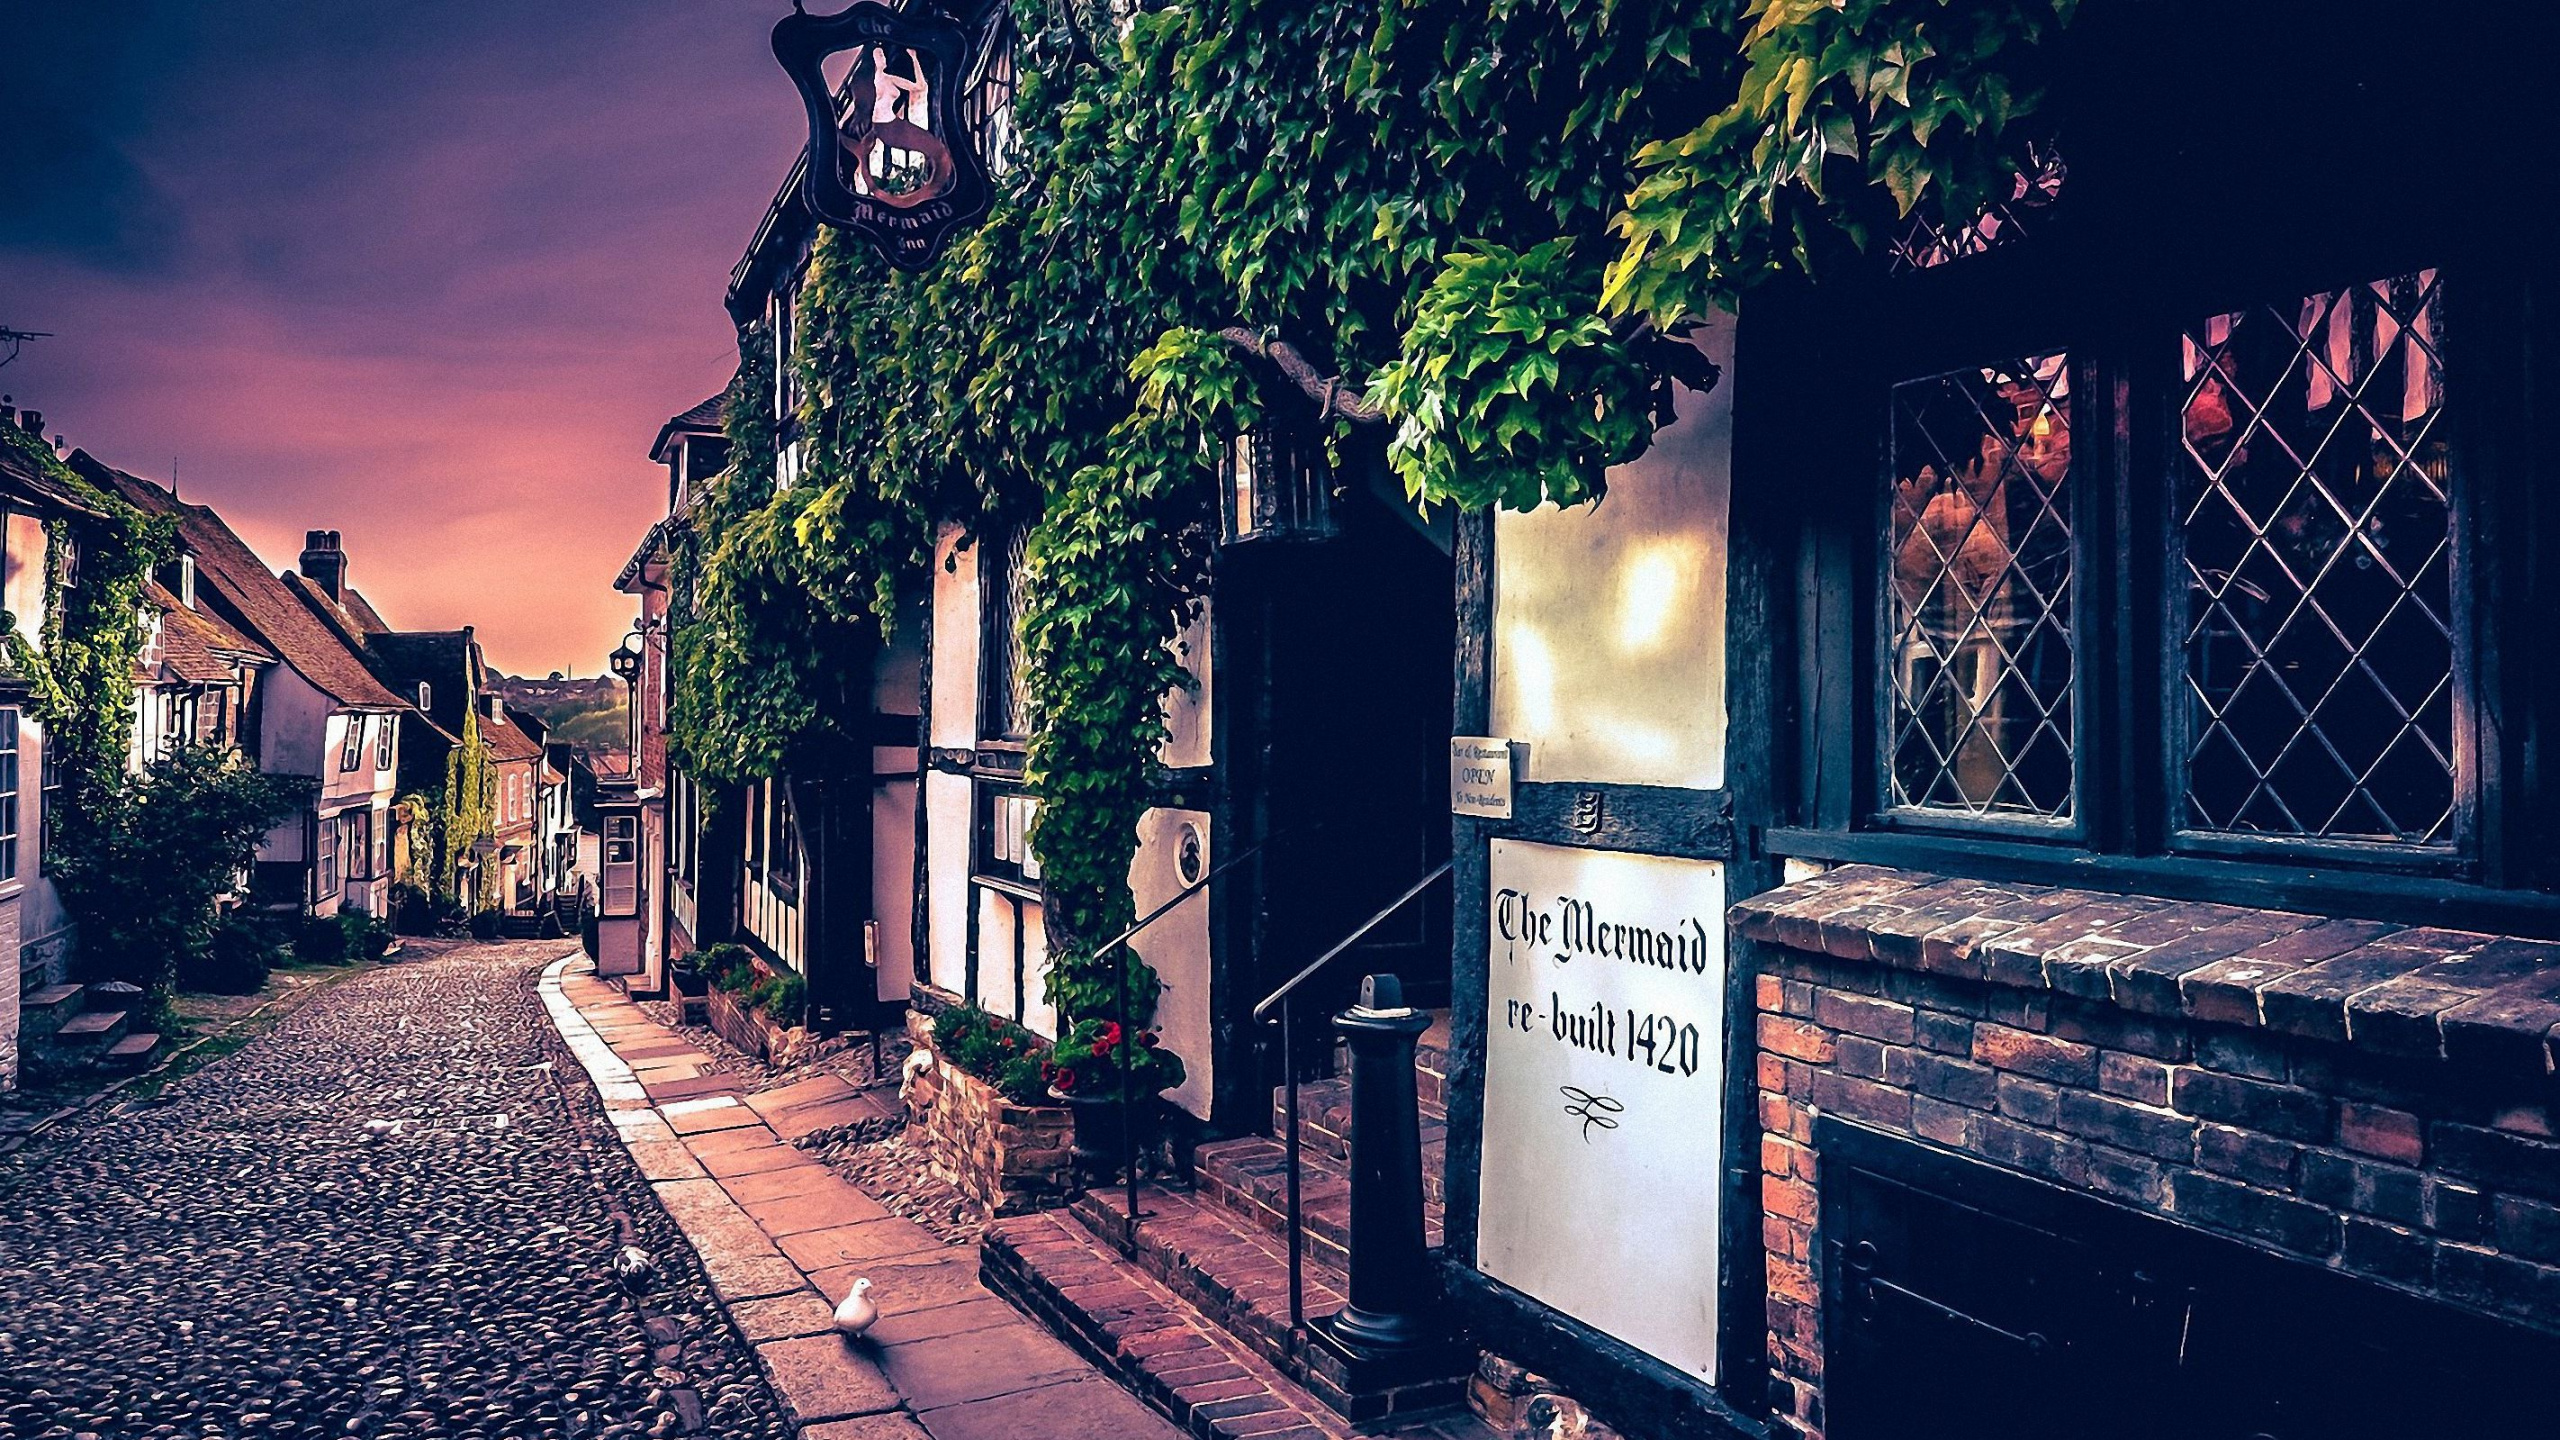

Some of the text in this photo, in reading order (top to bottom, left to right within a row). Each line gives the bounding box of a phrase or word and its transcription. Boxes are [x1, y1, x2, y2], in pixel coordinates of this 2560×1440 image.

[858, 17, 892, 35] The
[851, 200, 953, 230] Mermaid
[897, 235, 926, 254] Inn
[1462, 767, 1496, 786] OPEN
[1495, 888, 1707, 975] The Mermaid
[1508, 991, 1700, 1077] re-built 1420
